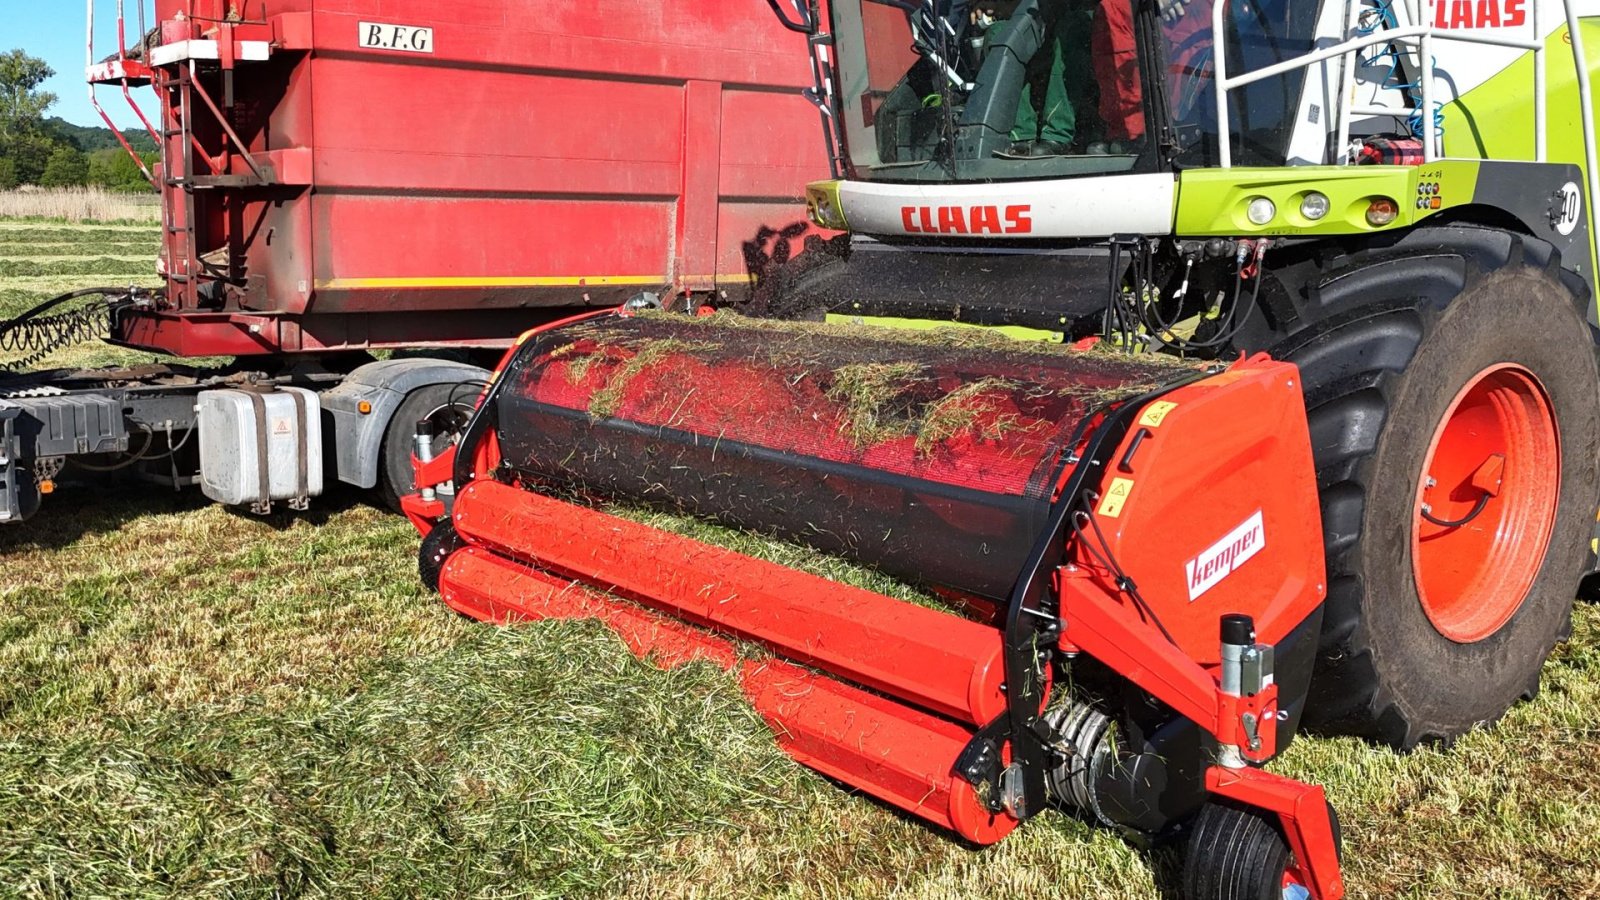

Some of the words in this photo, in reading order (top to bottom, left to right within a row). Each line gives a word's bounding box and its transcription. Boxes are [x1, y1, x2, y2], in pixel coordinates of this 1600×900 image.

[1429, 0, 1526, 29] LAAS
[367, 25, 427, 50] B.F.G
[901, 205, 1032, 234] CLAAS
[1191, 524, 1260, 590] kemper
